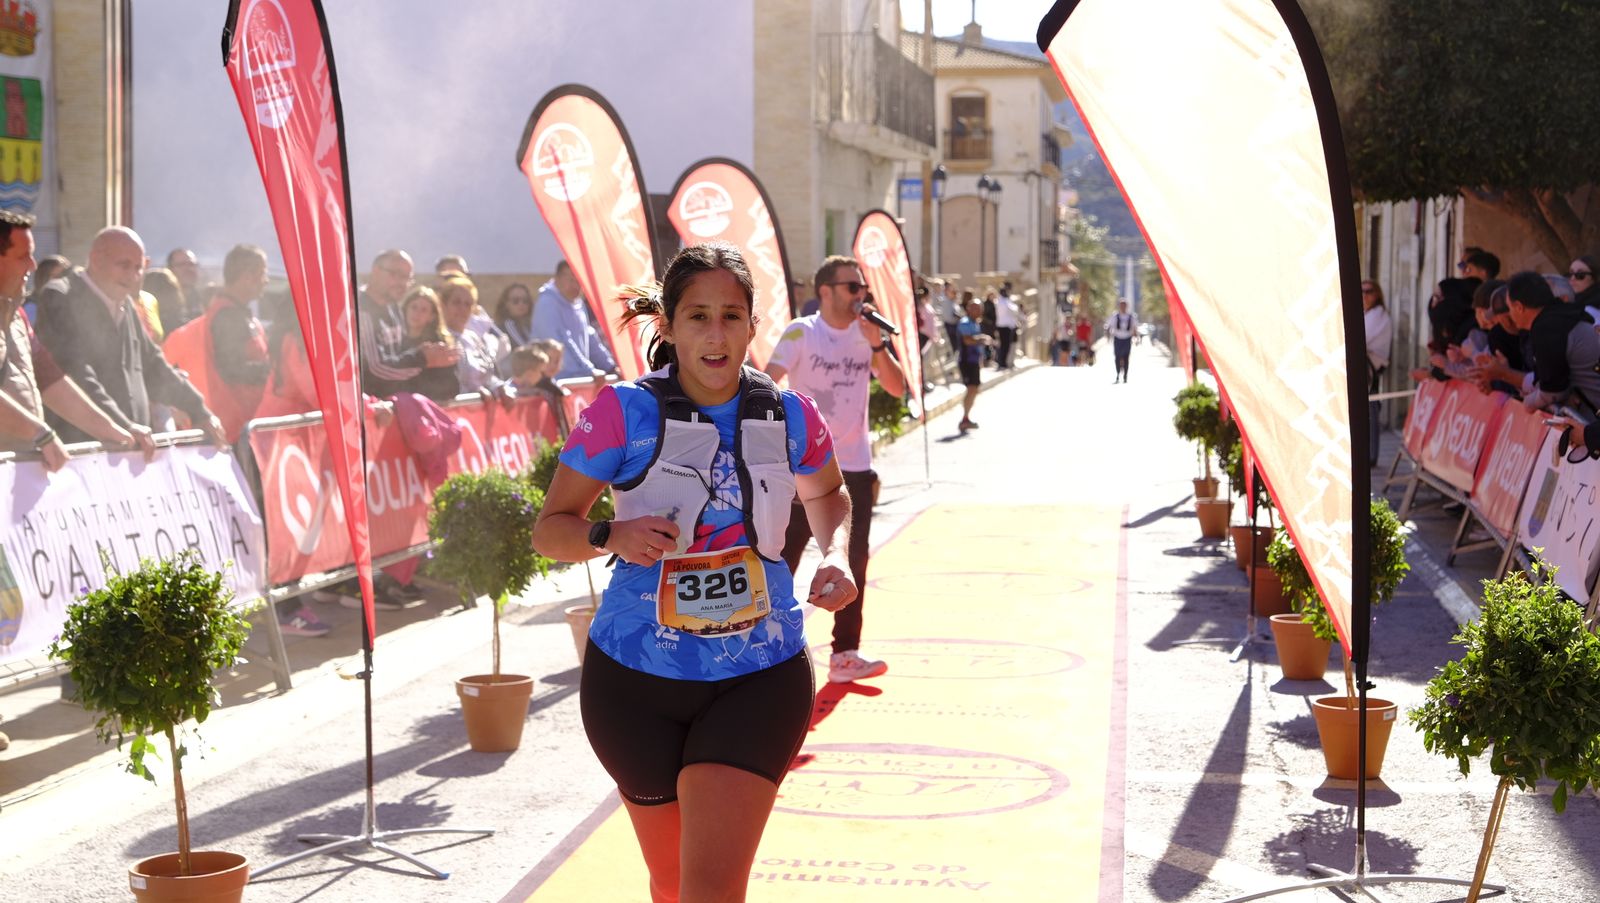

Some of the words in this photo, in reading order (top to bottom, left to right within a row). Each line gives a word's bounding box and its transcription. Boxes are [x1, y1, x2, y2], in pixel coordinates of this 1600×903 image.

[661, 466, 698, 479] SALOMON
[322, 455, 430, 524] VOLIA
[31, 515, 250, 600] CANTORIA
[678, 567, 748, 602] 326
[655, 640, 678, 650] adra
[752, 857, 896, 873] Canto
[748, 870, 992, 892] Ayuntamie
